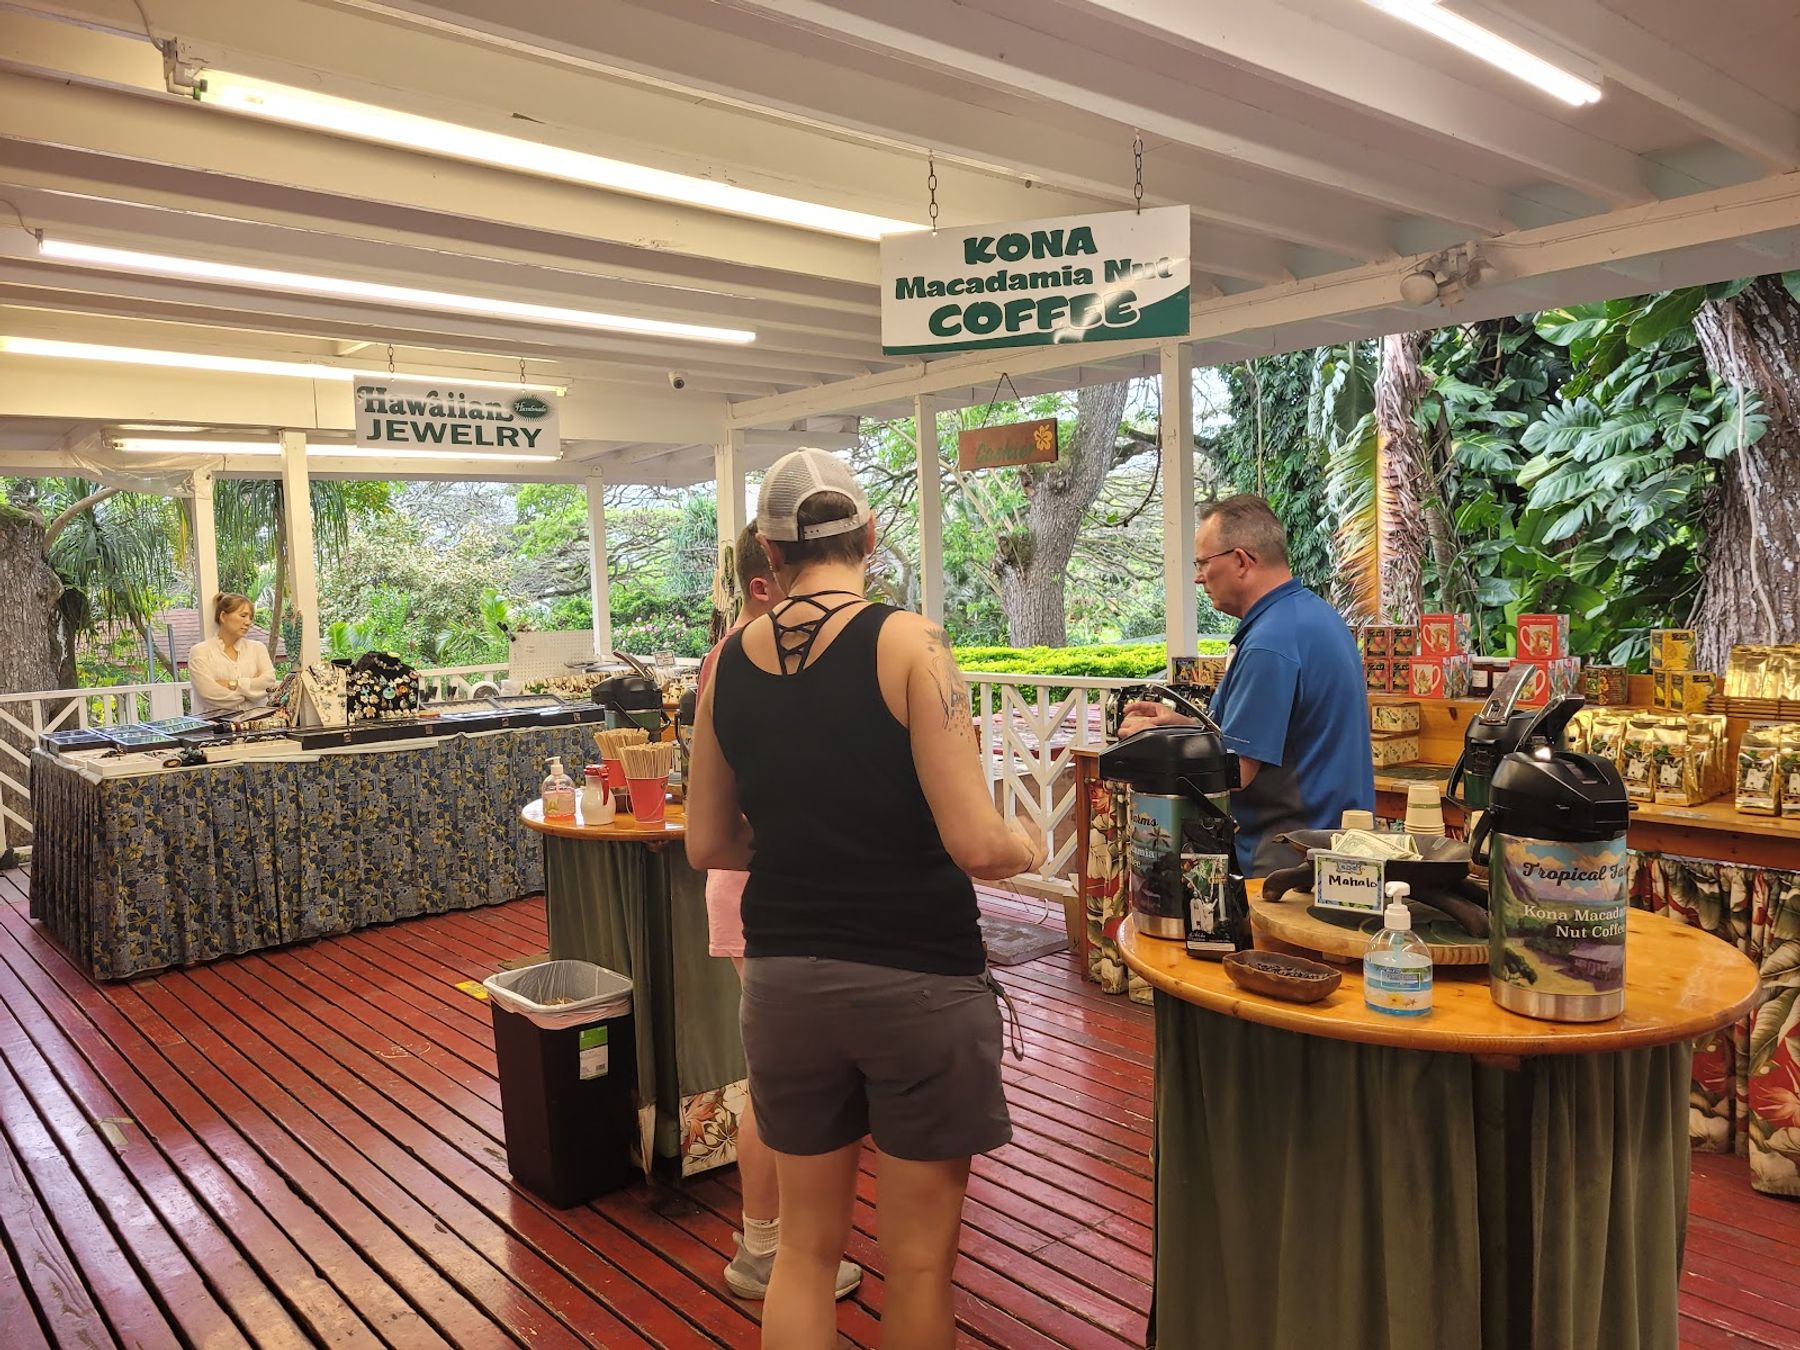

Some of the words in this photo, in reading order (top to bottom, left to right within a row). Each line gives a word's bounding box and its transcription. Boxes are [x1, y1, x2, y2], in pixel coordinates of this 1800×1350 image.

[963, 226, 1098, 265] KONA
[895, 265, 1093, 299] Macadamia
[1103, 256, 1173, 284] Nut
[928, 290, 1138, 337] COFFEE
[356, 386, 514, 422] Hawaiian
[366, 419, 542, 448] JEWELRY
[1328, 875, 1377, 888] Mahalo
[1523, 862, 1607, 886] Tropical
[1524, 905, 1569, 921] Kona
[1556, 925, 1587, 939] Nut
